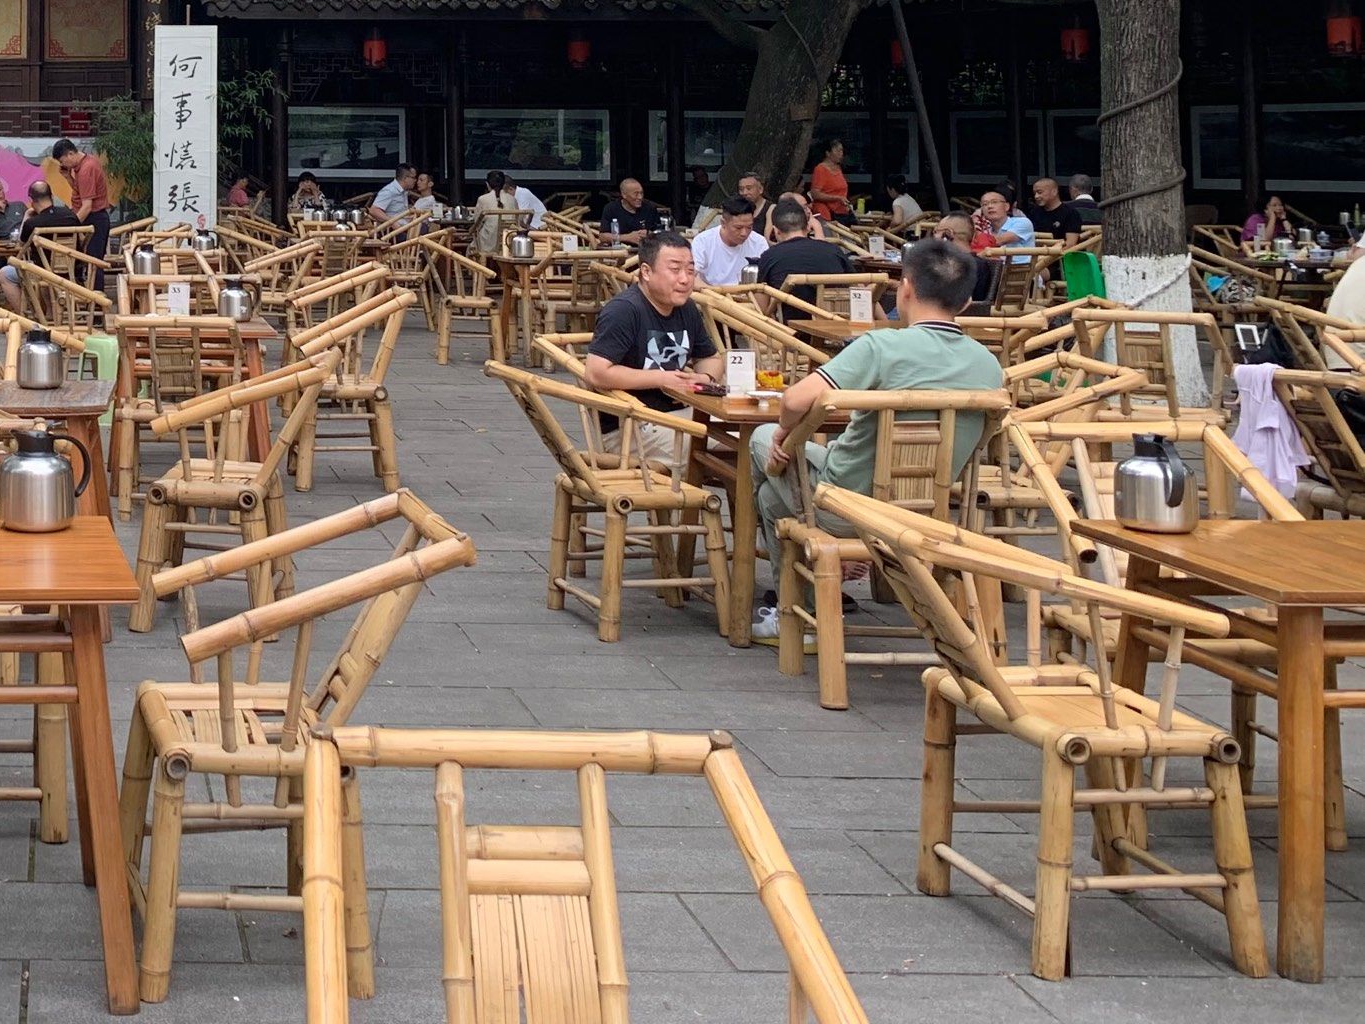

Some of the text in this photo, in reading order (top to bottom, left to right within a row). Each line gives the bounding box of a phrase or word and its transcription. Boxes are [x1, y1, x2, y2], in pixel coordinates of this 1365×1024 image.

[165, 54, 202, 213] 何事慌張
[731, 356, 743, 364] 22
